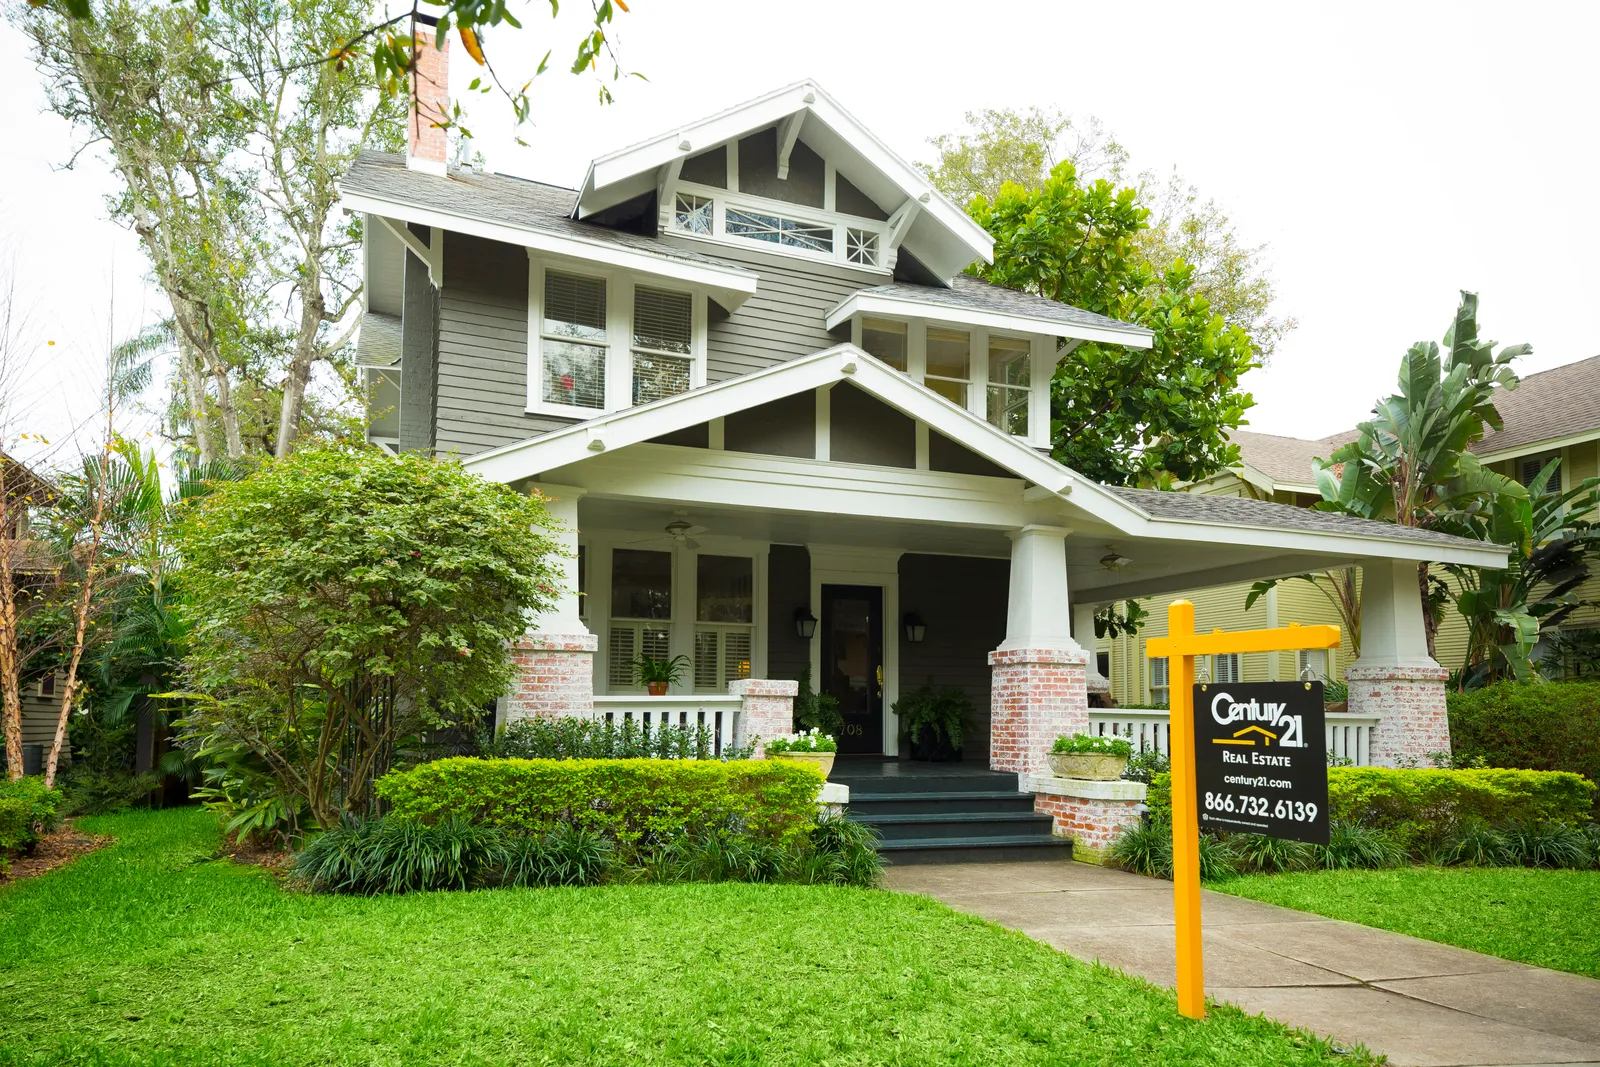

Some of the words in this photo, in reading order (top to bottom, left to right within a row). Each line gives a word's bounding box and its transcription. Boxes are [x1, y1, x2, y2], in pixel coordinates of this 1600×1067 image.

[1211, 692, 1287, 726] Century
[1278, 714, 1303, 748] 21
[840, 724, 863, 736] 708
[1222, 750, 1248, 764] REAL
[1252, 752, 1291, 767] ESTATE
[1224, 774, 1292, 789] century21.com
[1205, 791, 1318, 823] 866.732.6139
